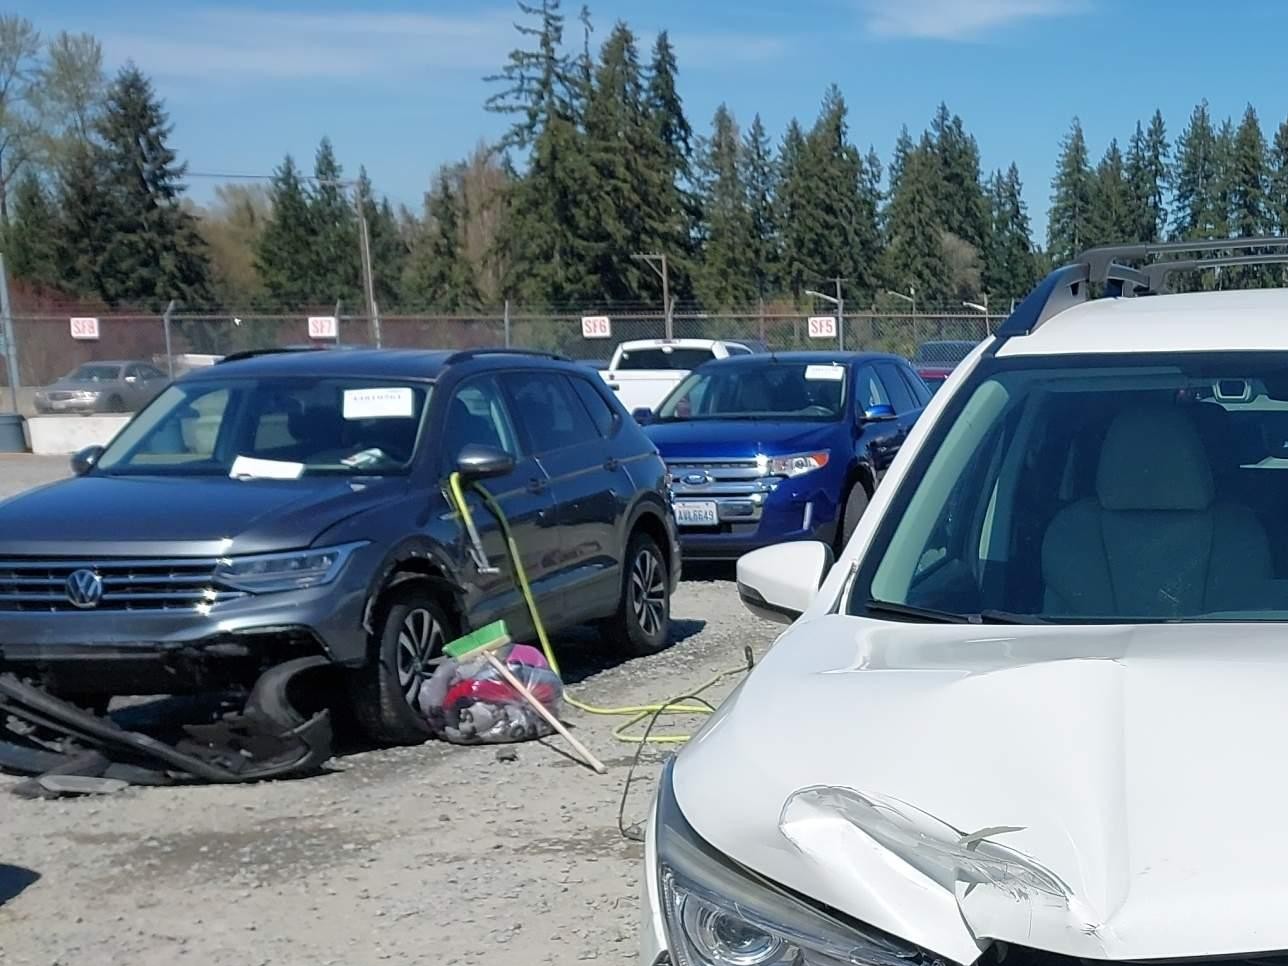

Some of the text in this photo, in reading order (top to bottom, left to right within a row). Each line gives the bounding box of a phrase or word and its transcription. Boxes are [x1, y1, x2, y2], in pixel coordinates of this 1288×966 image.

[311, 319, 332, 334] SF7
[584, 319, 607, 334] SF6
[810, 319, 833, 334] SF5
